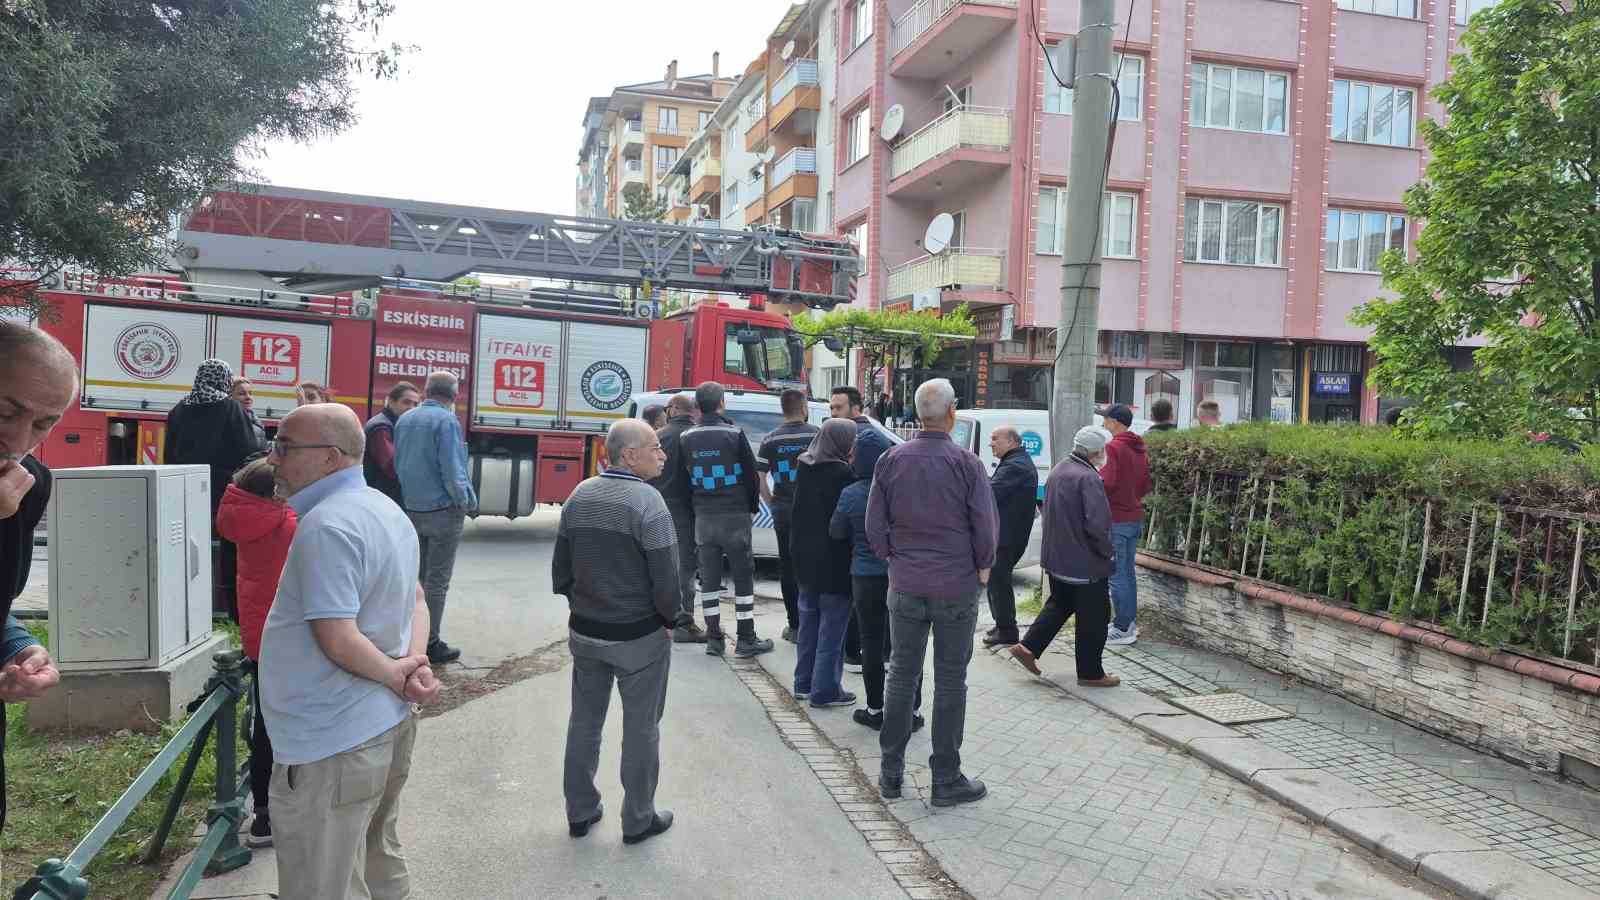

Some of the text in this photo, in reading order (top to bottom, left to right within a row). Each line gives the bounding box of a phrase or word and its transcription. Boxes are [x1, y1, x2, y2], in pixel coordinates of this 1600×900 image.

[384, 309, 465, 330] ESKİŞEHİR
[250, 336, 291, 362] 112
[375, 343, 470, 364] BÜYÜKŞEHİR
[487, 338, 553, 358] İTFAİYE
[501, 364, 537, 388] 112
